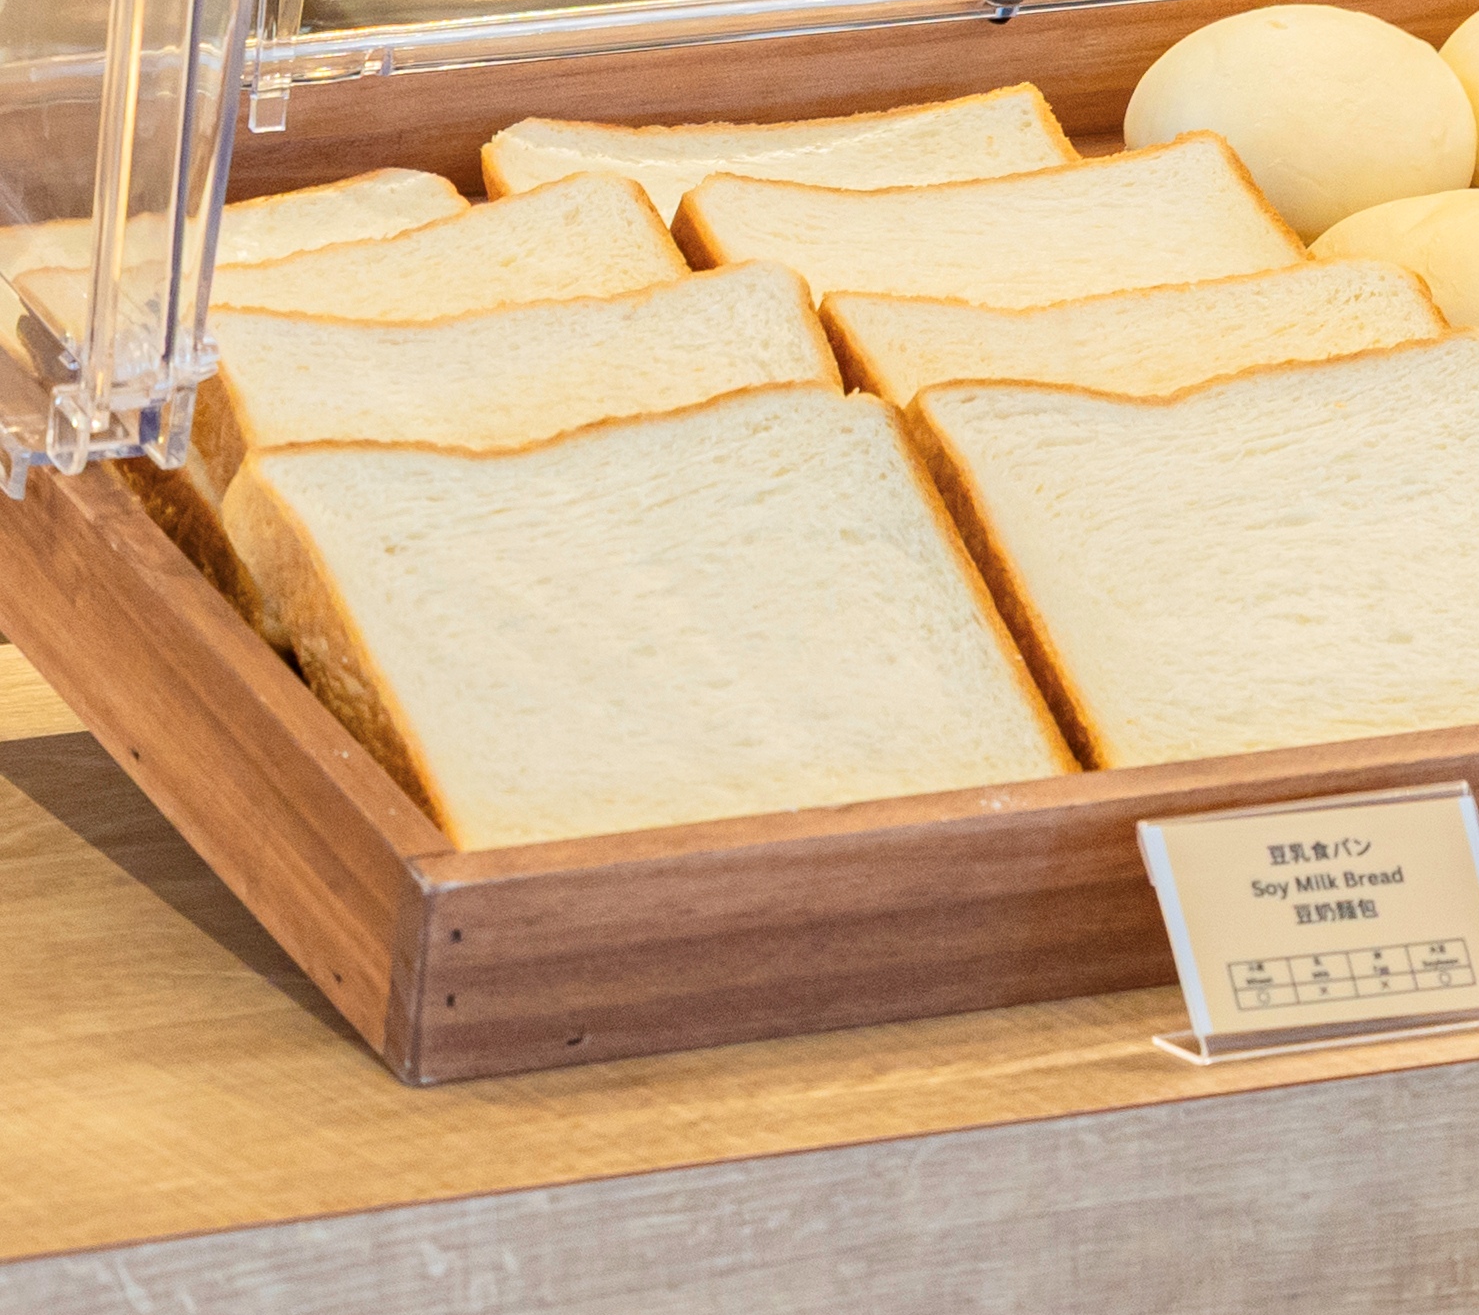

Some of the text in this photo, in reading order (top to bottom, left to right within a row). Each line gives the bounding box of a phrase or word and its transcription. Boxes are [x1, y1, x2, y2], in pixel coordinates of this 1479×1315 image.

[1268, 838, 1372, 867] 豆乳食パン
[1251, 867, 1404, 901] Soy Milk Bread
